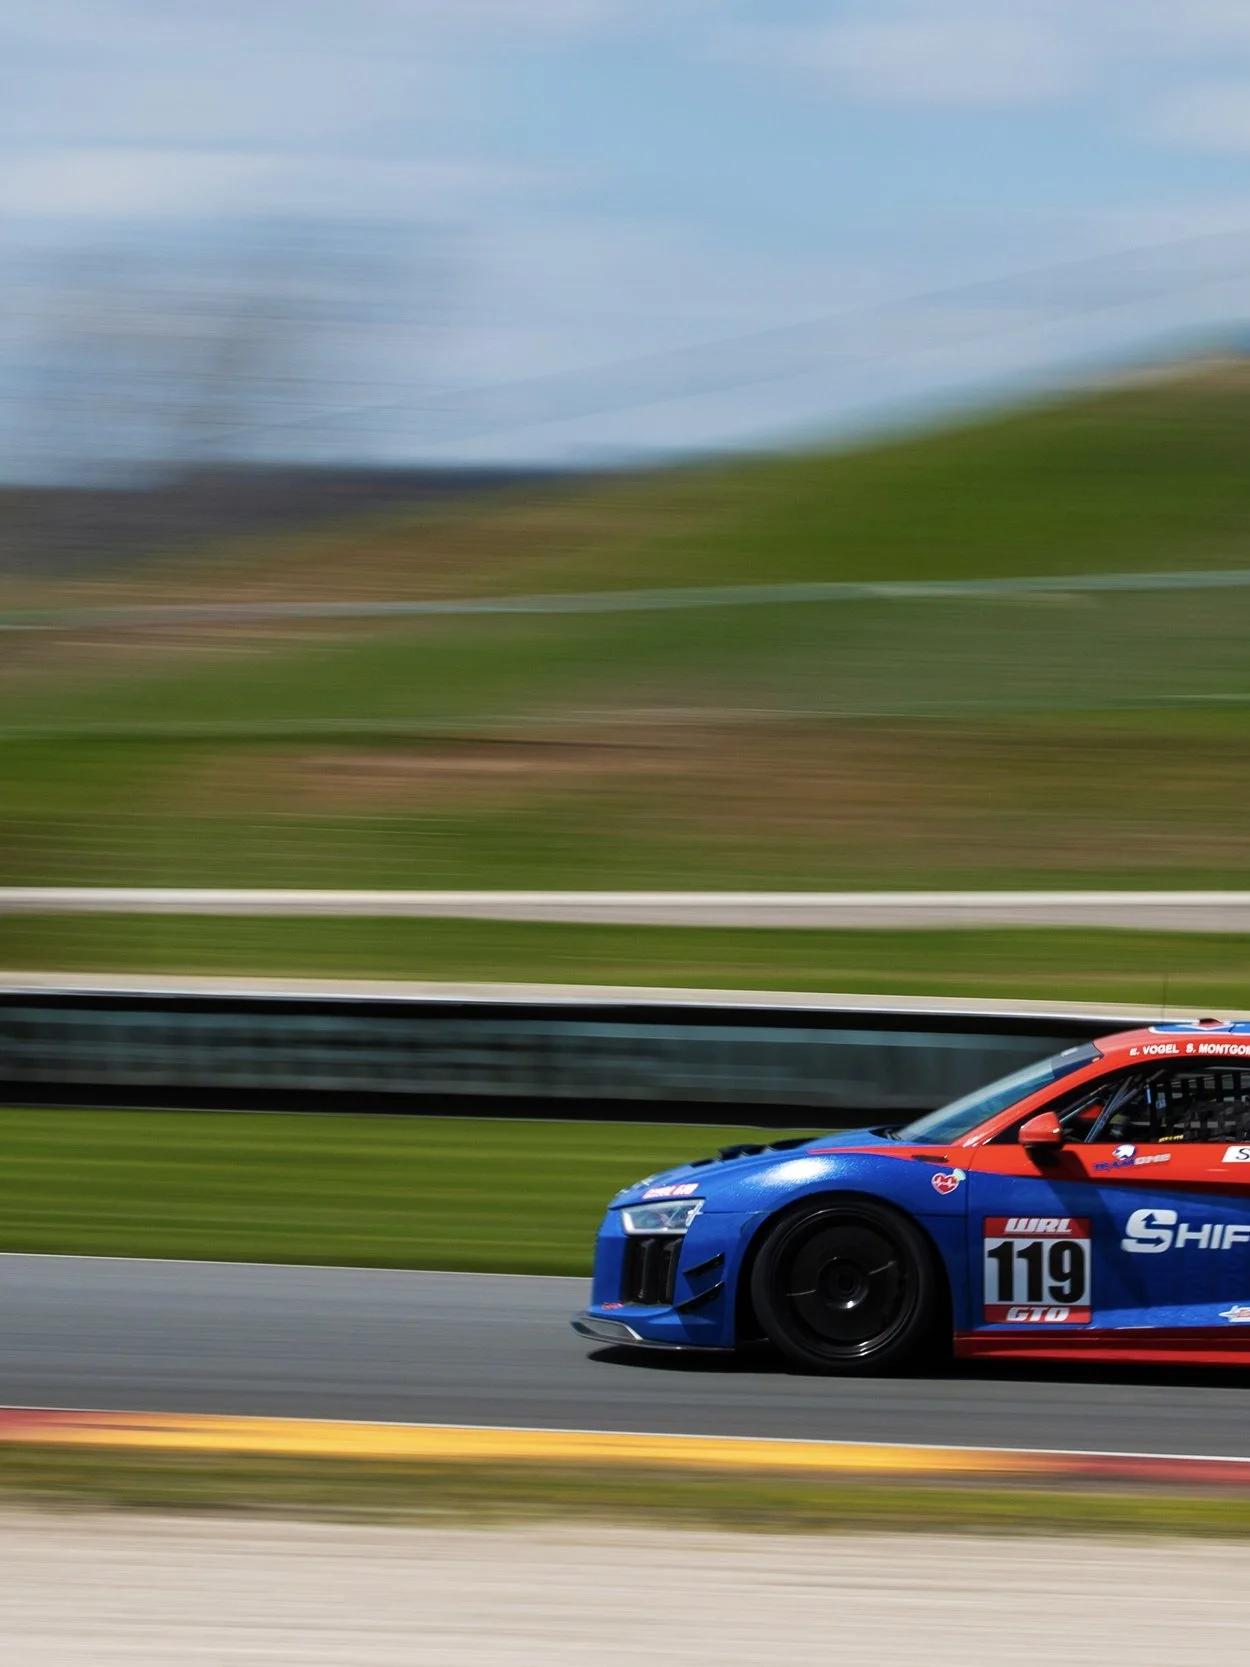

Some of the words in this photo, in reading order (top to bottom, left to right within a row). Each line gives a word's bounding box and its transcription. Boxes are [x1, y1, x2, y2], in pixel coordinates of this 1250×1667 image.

[1142, 1043, 1180, 1055] VOGEL
[1186, 1043, 1196, 1054] S.
[1004, 1217, 1072, 1233] WRL
[987, 1240, 1086, 1304] 119
[1006, 1306, 1070, 1322] GTO
